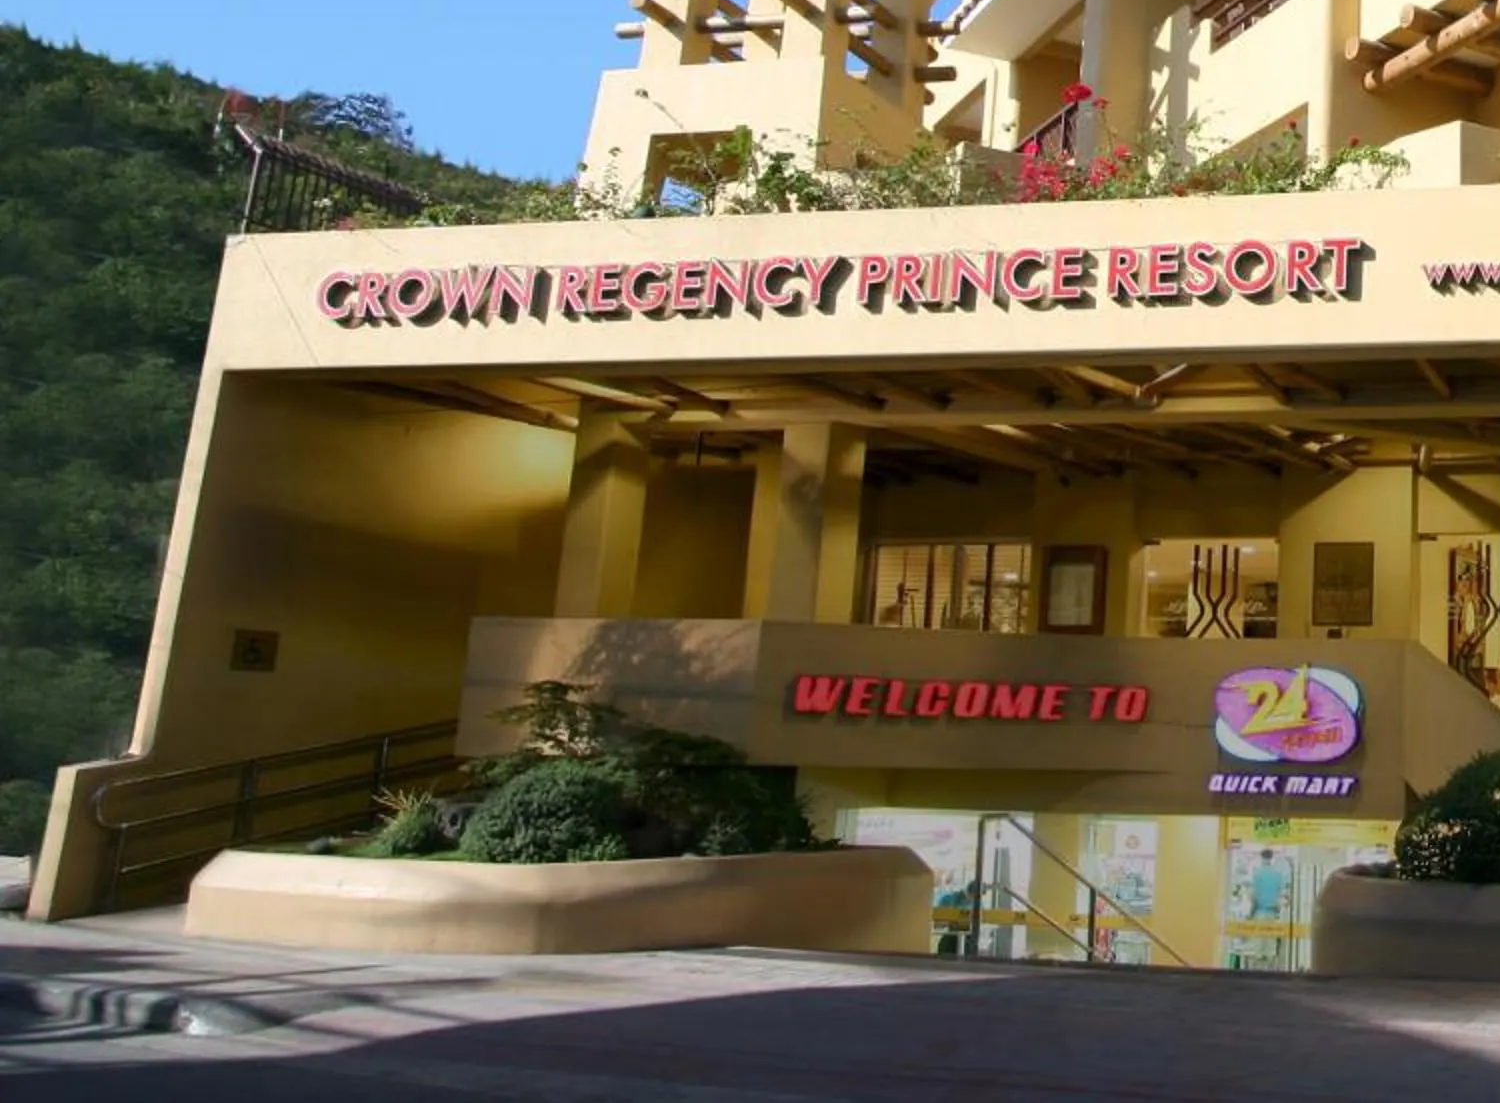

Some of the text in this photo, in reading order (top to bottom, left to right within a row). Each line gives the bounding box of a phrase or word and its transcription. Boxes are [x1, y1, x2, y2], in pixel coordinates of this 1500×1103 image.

[317, 238, 1363, 320] CROWN REGENCY PRINCE RESORT
[793, 676, 1150, 722] WELCOME TO
[1234, 663, 1320, 734] 24
[1208, 774, 1355, 795] QUICK MART
